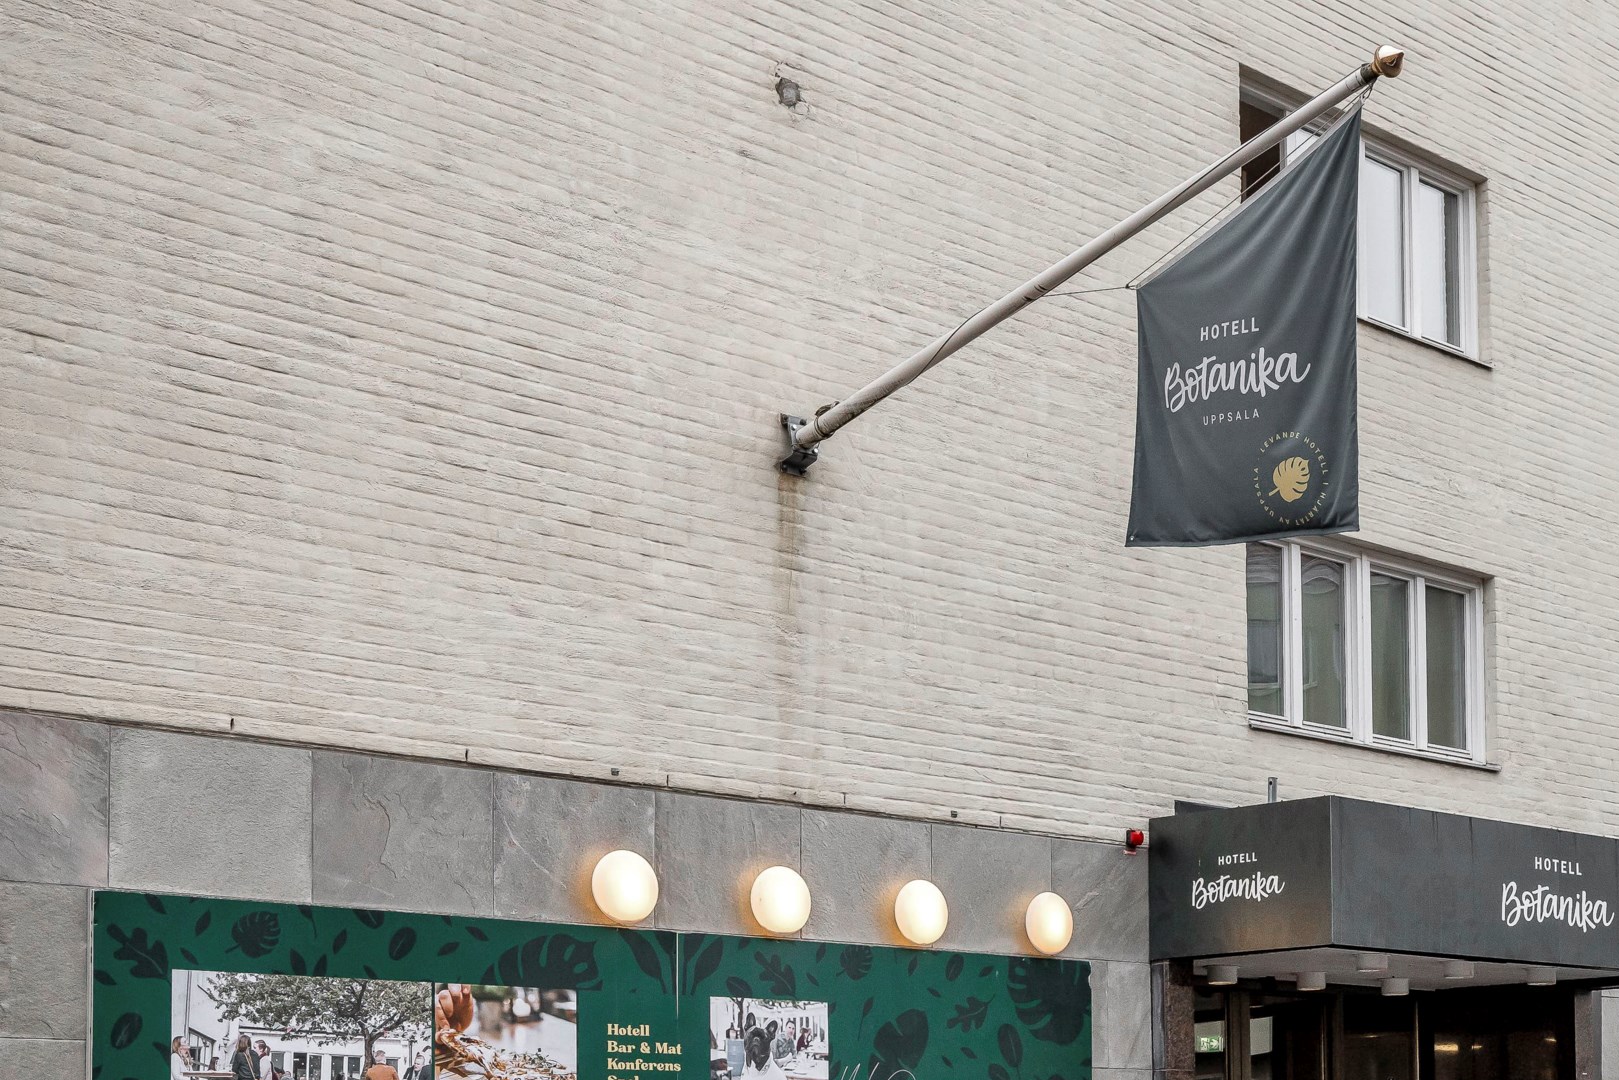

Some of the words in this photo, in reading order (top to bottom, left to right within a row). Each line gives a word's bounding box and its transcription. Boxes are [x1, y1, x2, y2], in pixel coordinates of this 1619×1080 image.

[1200, 317, 1260, 341] HOTELL
[1164, 347, 1311, 413] Botanika
[1203, 408, 1259, 425] UPPSALA
[1260, 432, 1300, 453] LEVANDE
[1303, 437, 1329, 475] HOTELL
[1253, 467, 1275, 517] UPPSALA
[1218, 852, 1258, 866] HOTELL
[1534, 856, 1582, 876] HOTELL
[1191, 871, 1285, 910] Botanika
[1501, 881, 1615, 933] Botanika
[607, 1023, 650, 1036] Hotell
[607, 1040, 636, 1053] Bar
[640, 1042, 651, 1054] &
[655, 1042, 682, 1055] Mat
[607, 1058, 682, 1072] Konferens
